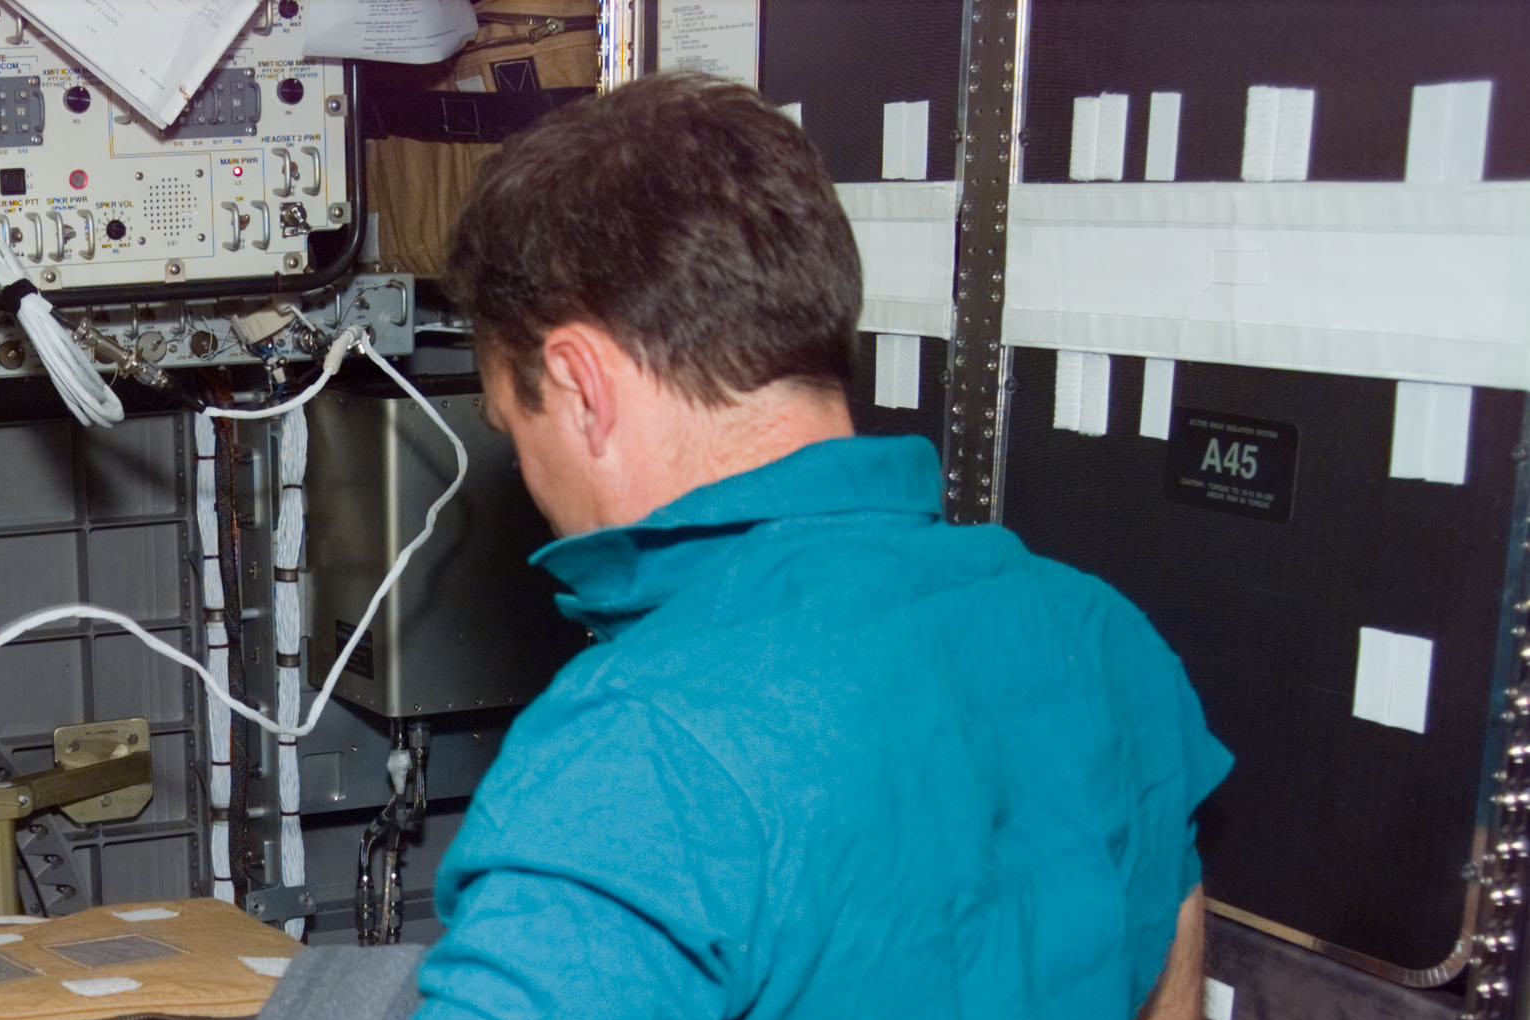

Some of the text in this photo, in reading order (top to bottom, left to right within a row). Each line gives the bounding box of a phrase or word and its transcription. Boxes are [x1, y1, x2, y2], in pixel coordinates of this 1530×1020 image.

[258, 60, 293, 68] XMIT/ICOM
[261, 135, 296, 143] HEADSET
[46, 197, 68, 205] SPKR
[1200, 437, 1258, 479] A45
